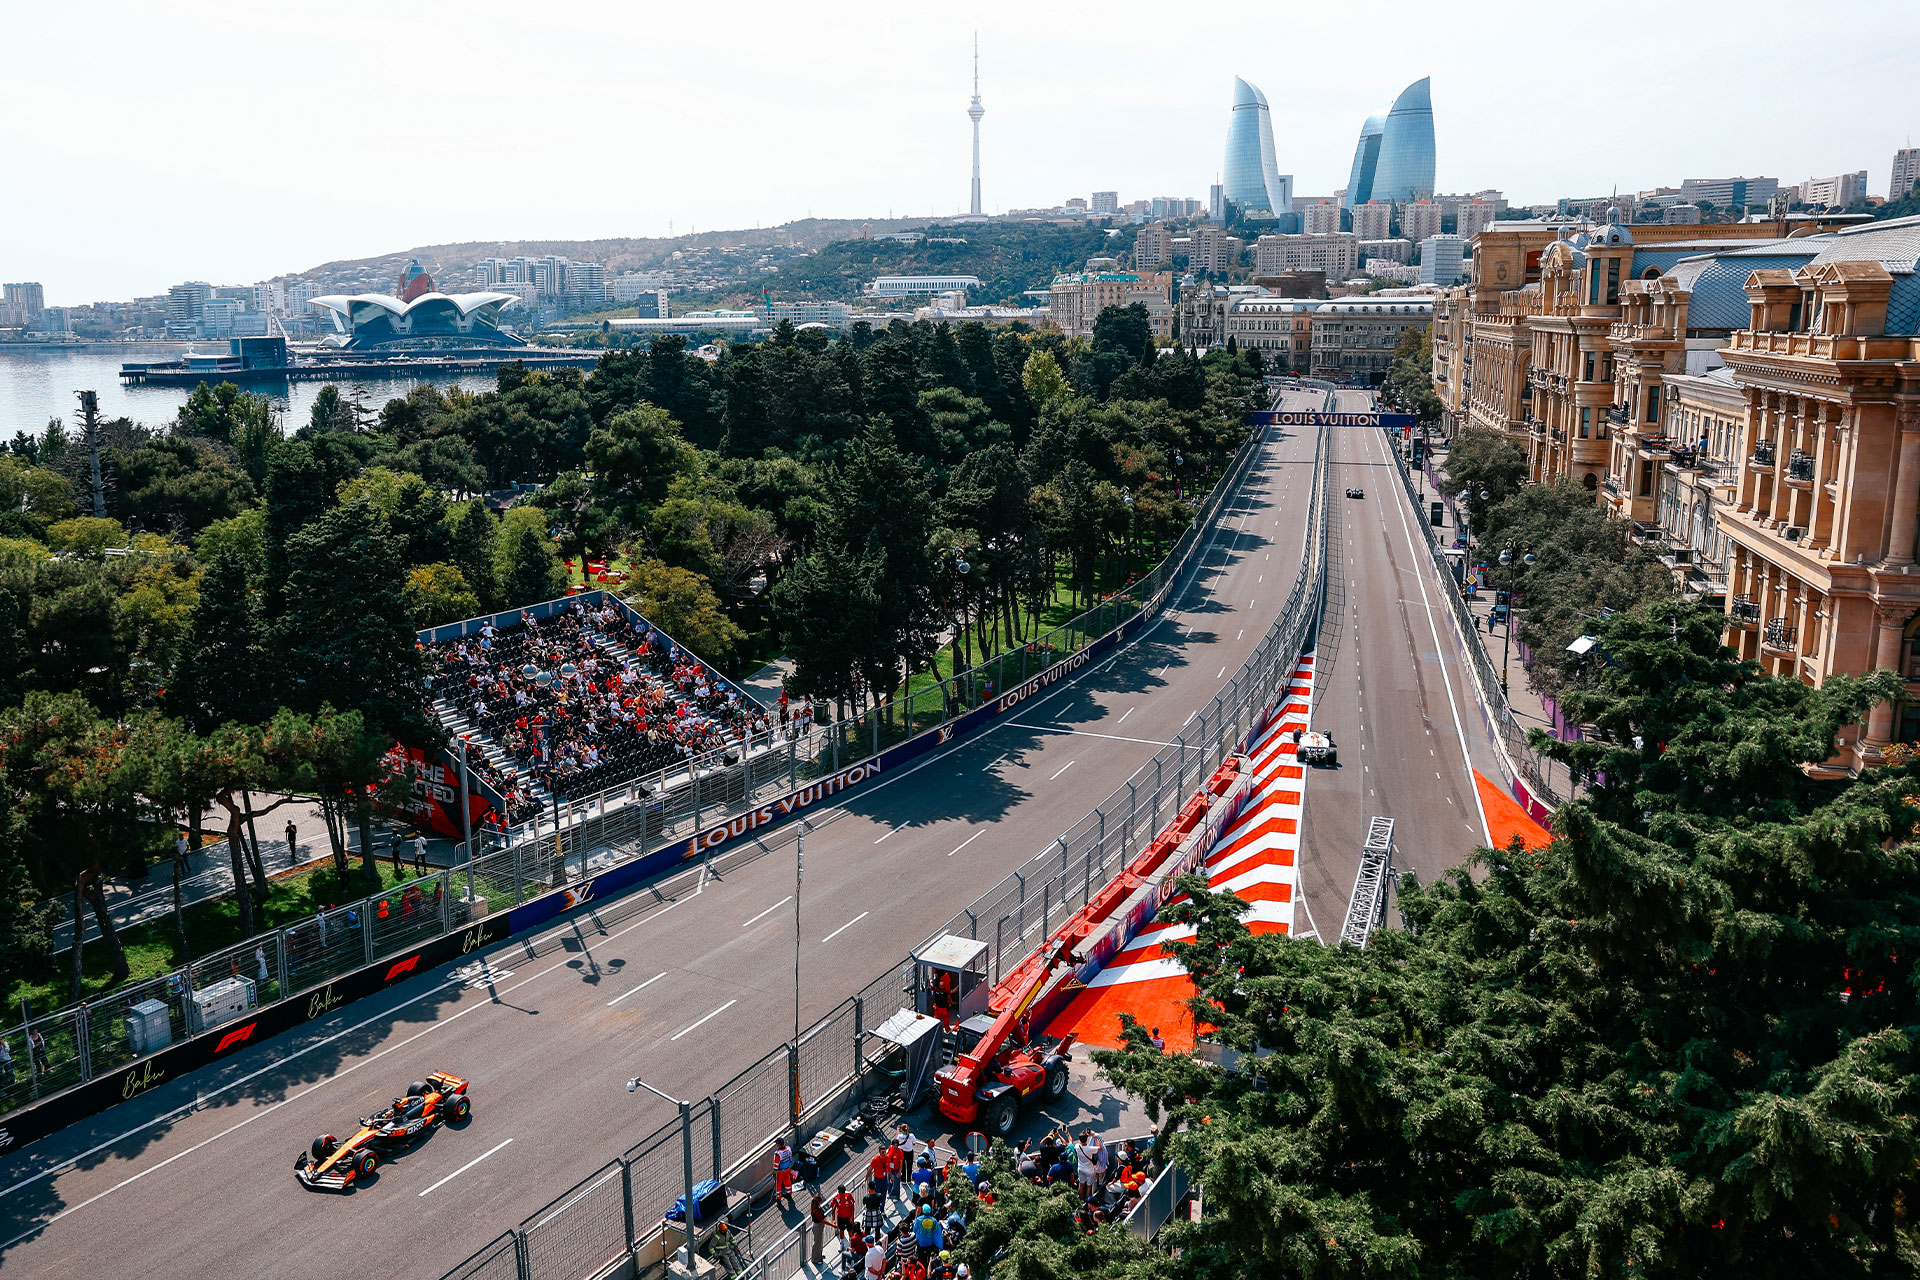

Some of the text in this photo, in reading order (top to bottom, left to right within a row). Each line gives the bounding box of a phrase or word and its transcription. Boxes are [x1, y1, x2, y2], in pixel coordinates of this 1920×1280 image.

[1275, 413, 1380, 426] LOUIS VUITTON
[1000, 650, 1090, 712] LOUIS VUITTON
[691, 757, 881, 855] LOUIS VUITTON
[463, 923, 493, 954] Baku
[308, 984, 343, 1019] Baku
[122, 1060, 165, 1099] Baku
